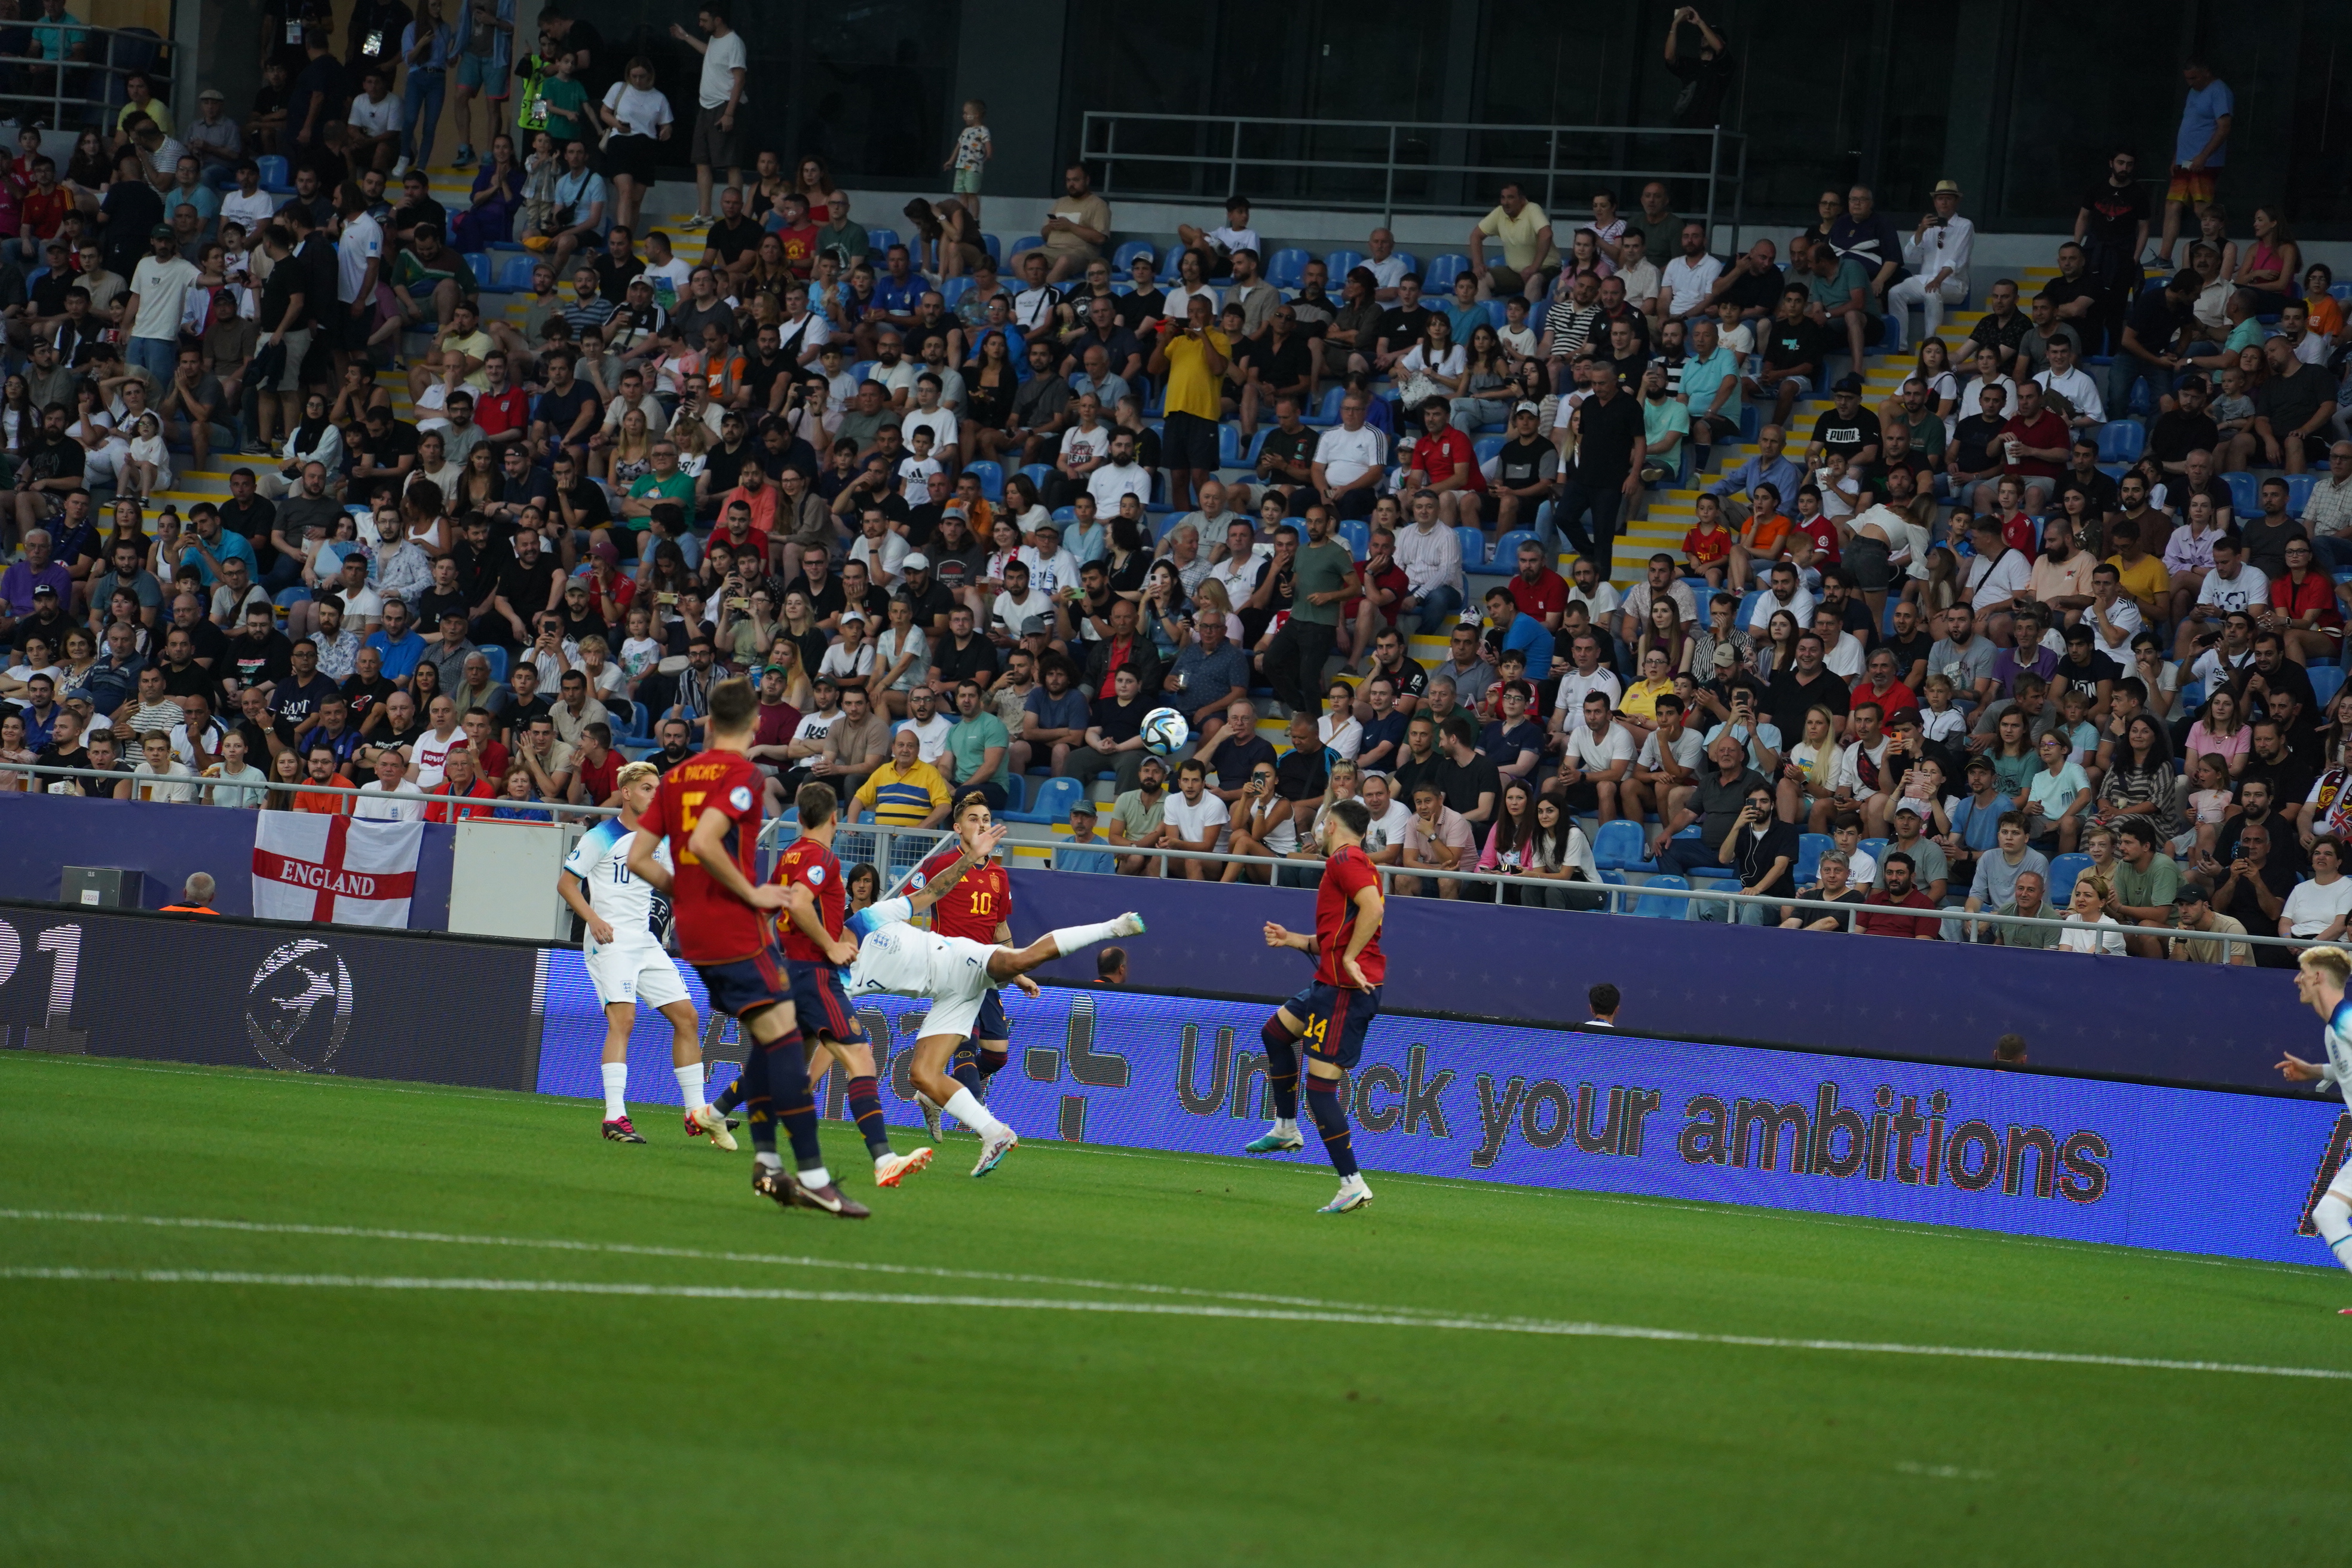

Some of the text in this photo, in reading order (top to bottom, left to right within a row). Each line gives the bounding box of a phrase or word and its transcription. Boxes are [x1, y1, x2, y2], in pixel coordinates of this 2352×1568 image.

[1830, 430, 1855, 441] PUMA
[679, 791, 708, 865] 5
[280, 860, 375, 896] ENGLAND
[613, 862, 630, 883] 10
[970, 891, 992, 915] 10
[866, 978, 887, 990] 7
[1303, 1012, 1328, 1043] 14
[1178, 1023, 2111, 1205] Unock your ambitions
